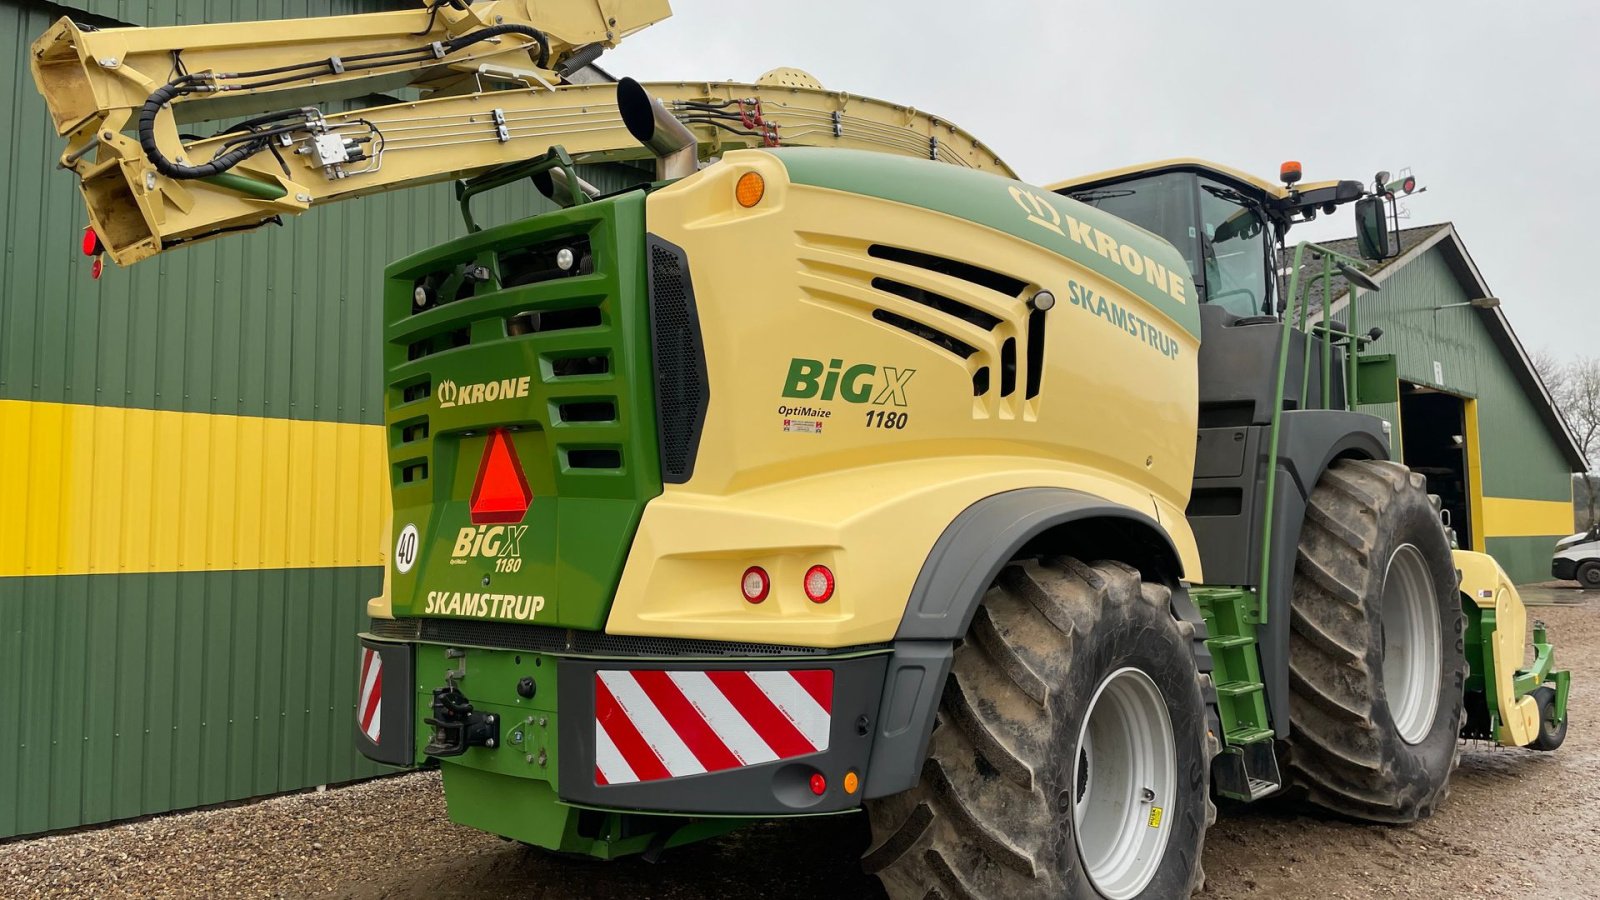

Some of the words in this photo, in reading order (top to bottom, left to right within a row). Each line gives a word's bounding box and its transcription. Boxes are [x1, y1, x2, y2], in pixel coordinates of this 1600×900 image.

[1065, 214, 1186, 305] KRONE
[1067, 280, 1179, 360] SKAMSTRUP
[457, 376, 531, 406] KRONE
[778, 405, 832, 418] OptiMaize
[865, 410, 909, 430] 1180
[398, 534, 417, 565] 40
[494, 558, 522, 573] 1180
[424, 591, 545, 621] SKAMSTRUP
